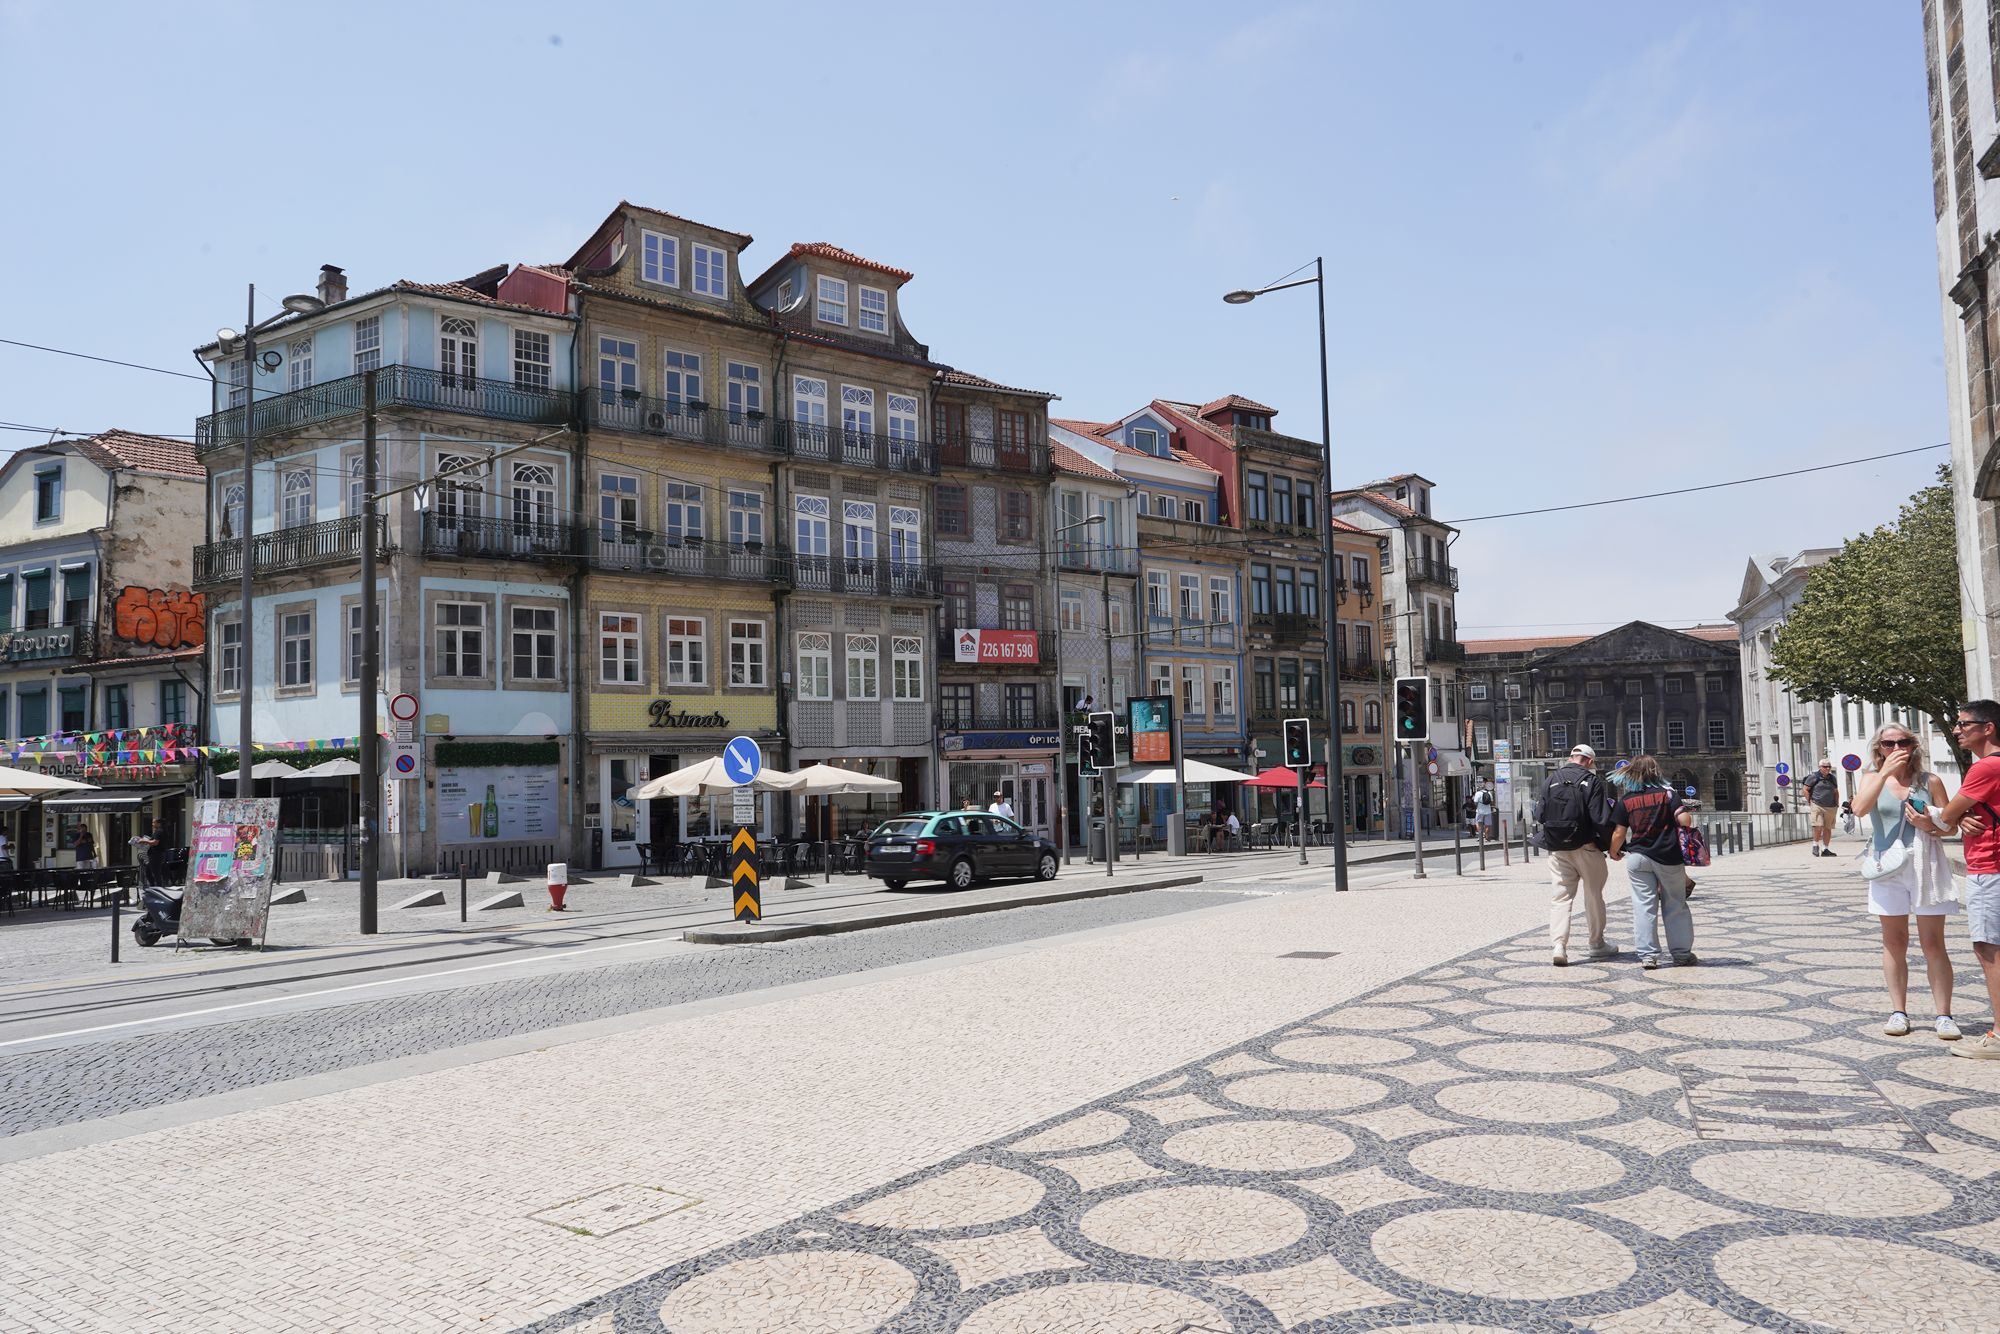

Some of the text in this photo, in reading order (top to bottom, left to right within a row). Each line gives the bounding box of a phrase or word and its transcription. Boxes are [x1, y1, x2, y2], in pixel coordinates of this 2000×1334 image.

[13, 634, 70, 653] D'OURO
[982, 642, 1034, 658] 226 167 590
